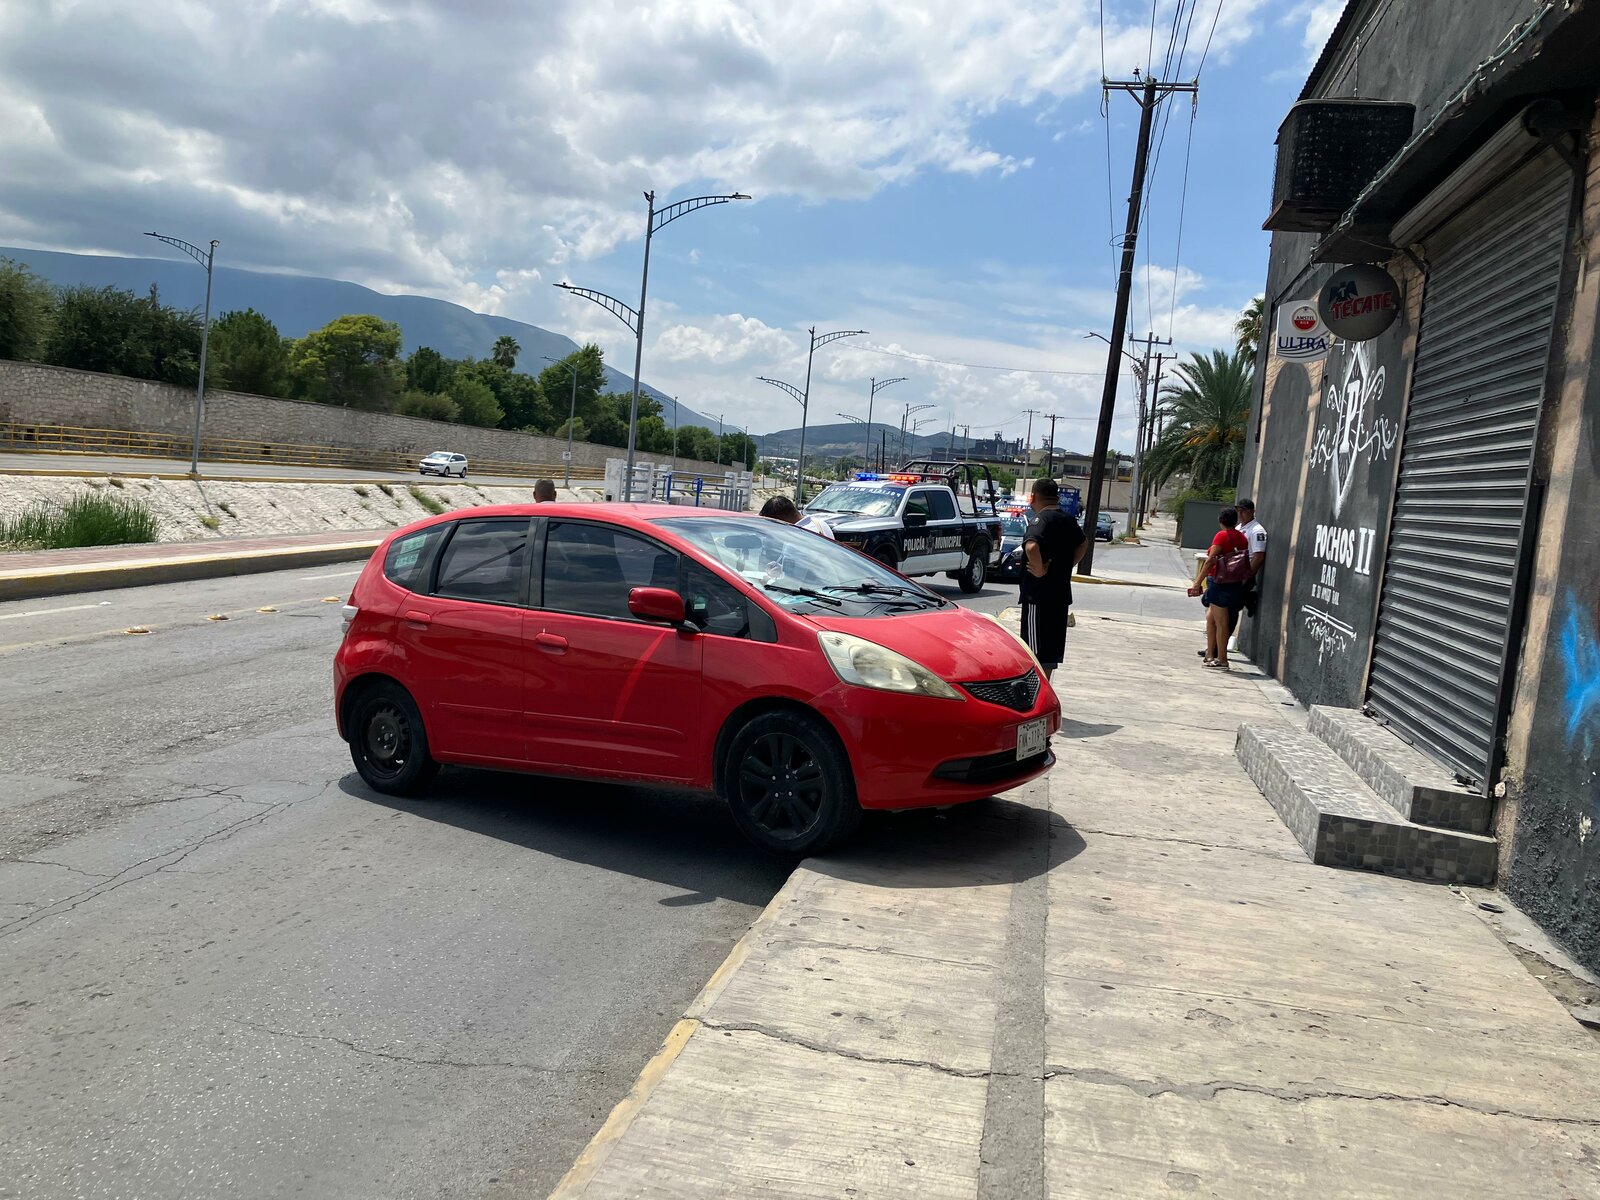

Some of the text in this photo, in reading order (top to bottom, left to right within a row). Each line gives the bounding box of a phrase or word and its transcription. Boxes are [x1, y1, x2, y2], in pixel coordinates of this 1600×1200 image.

[1328, 291, 1392, 320] TECATE
[1278, 336, 1326, 350] ULTRA
[935, 535, 962, 549] MUNICIPAL
[1313, 524, 1355, 568] POCHOS
[1320, 564, 1337, 587] BAR
